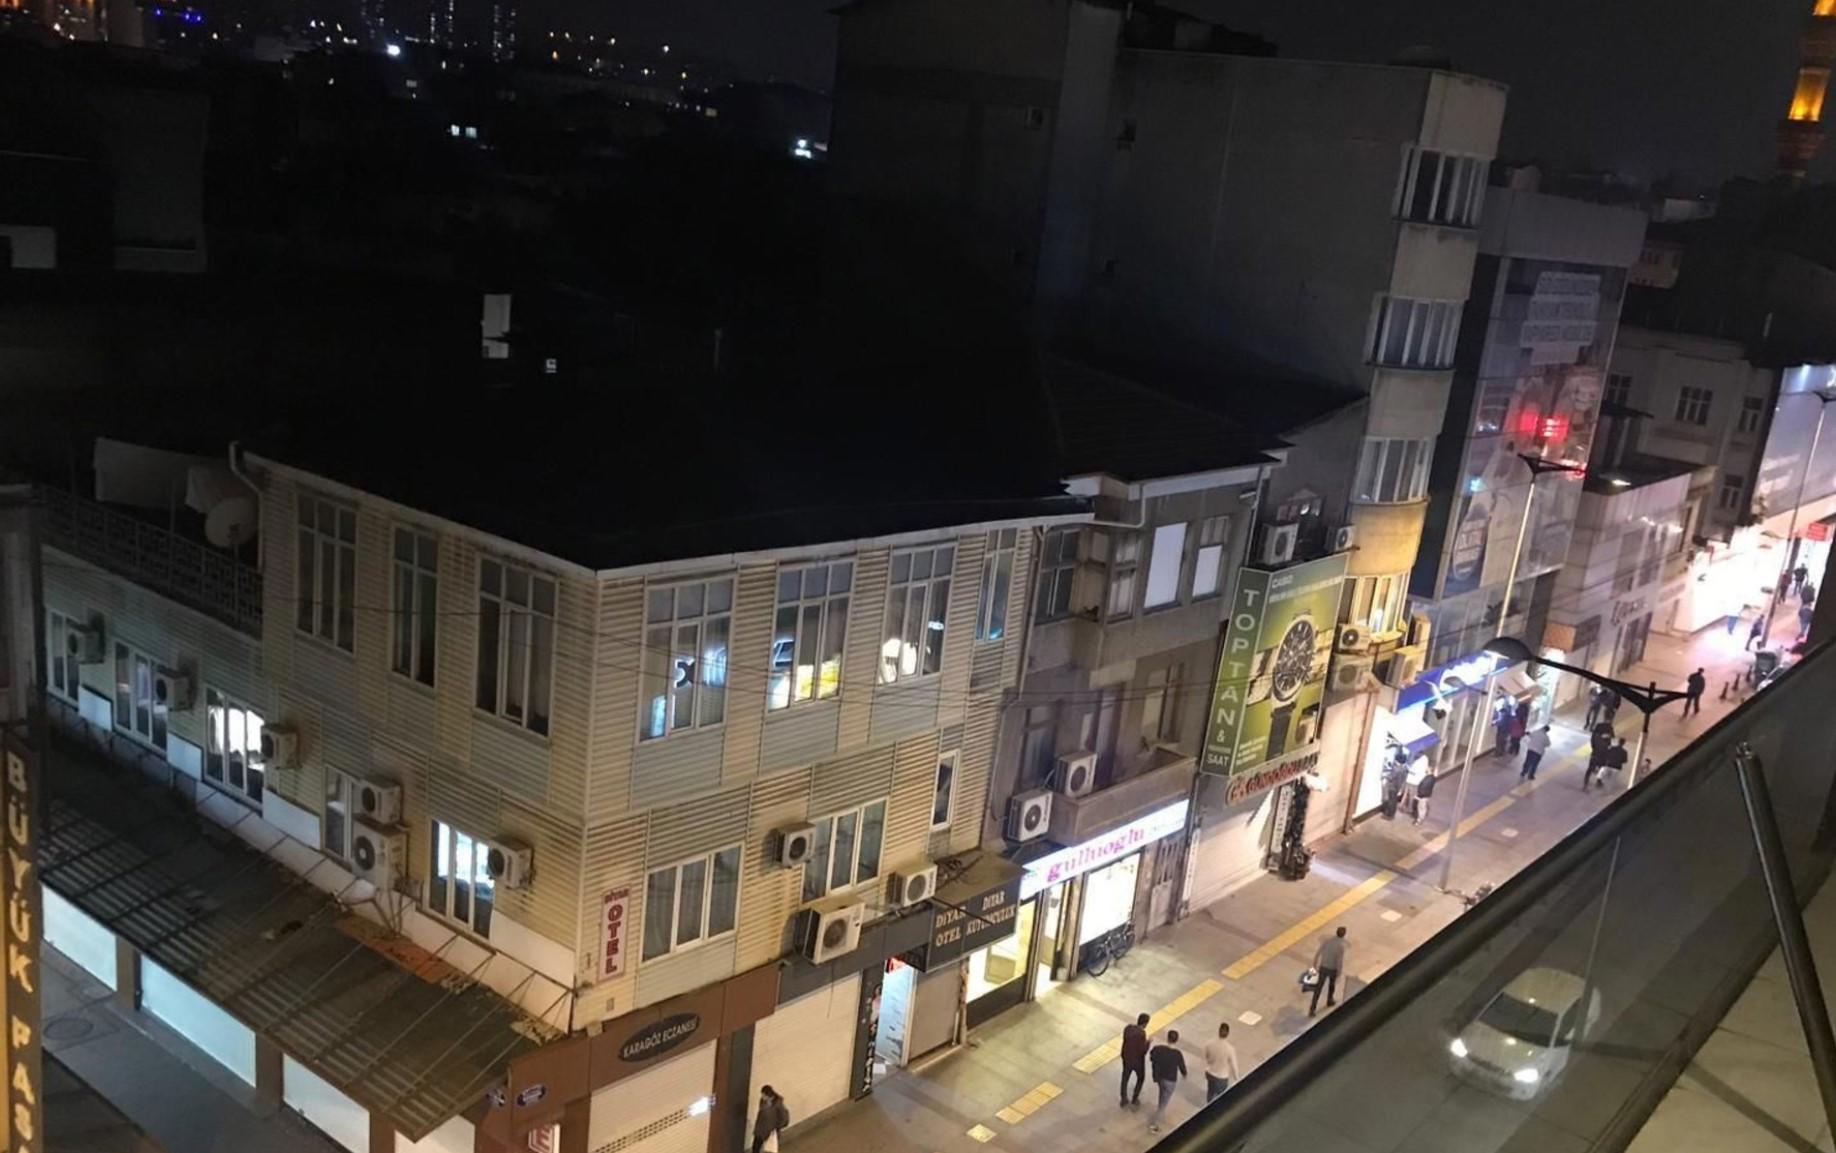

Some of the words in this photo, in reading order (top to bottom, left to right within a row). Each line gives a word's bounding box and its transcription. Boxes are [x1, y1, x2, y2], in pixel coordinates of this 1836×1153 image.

[1216, 588, 1260, 726] TOPTAN
[1216, 729, 1226, 743] &
[1207, 753, 1230, 767] SAAT
[7, 751, 33, 993] BÜYÜK
[605, 904, 624, 974] OTEL
[936, 927, 961, 947] OTEL
